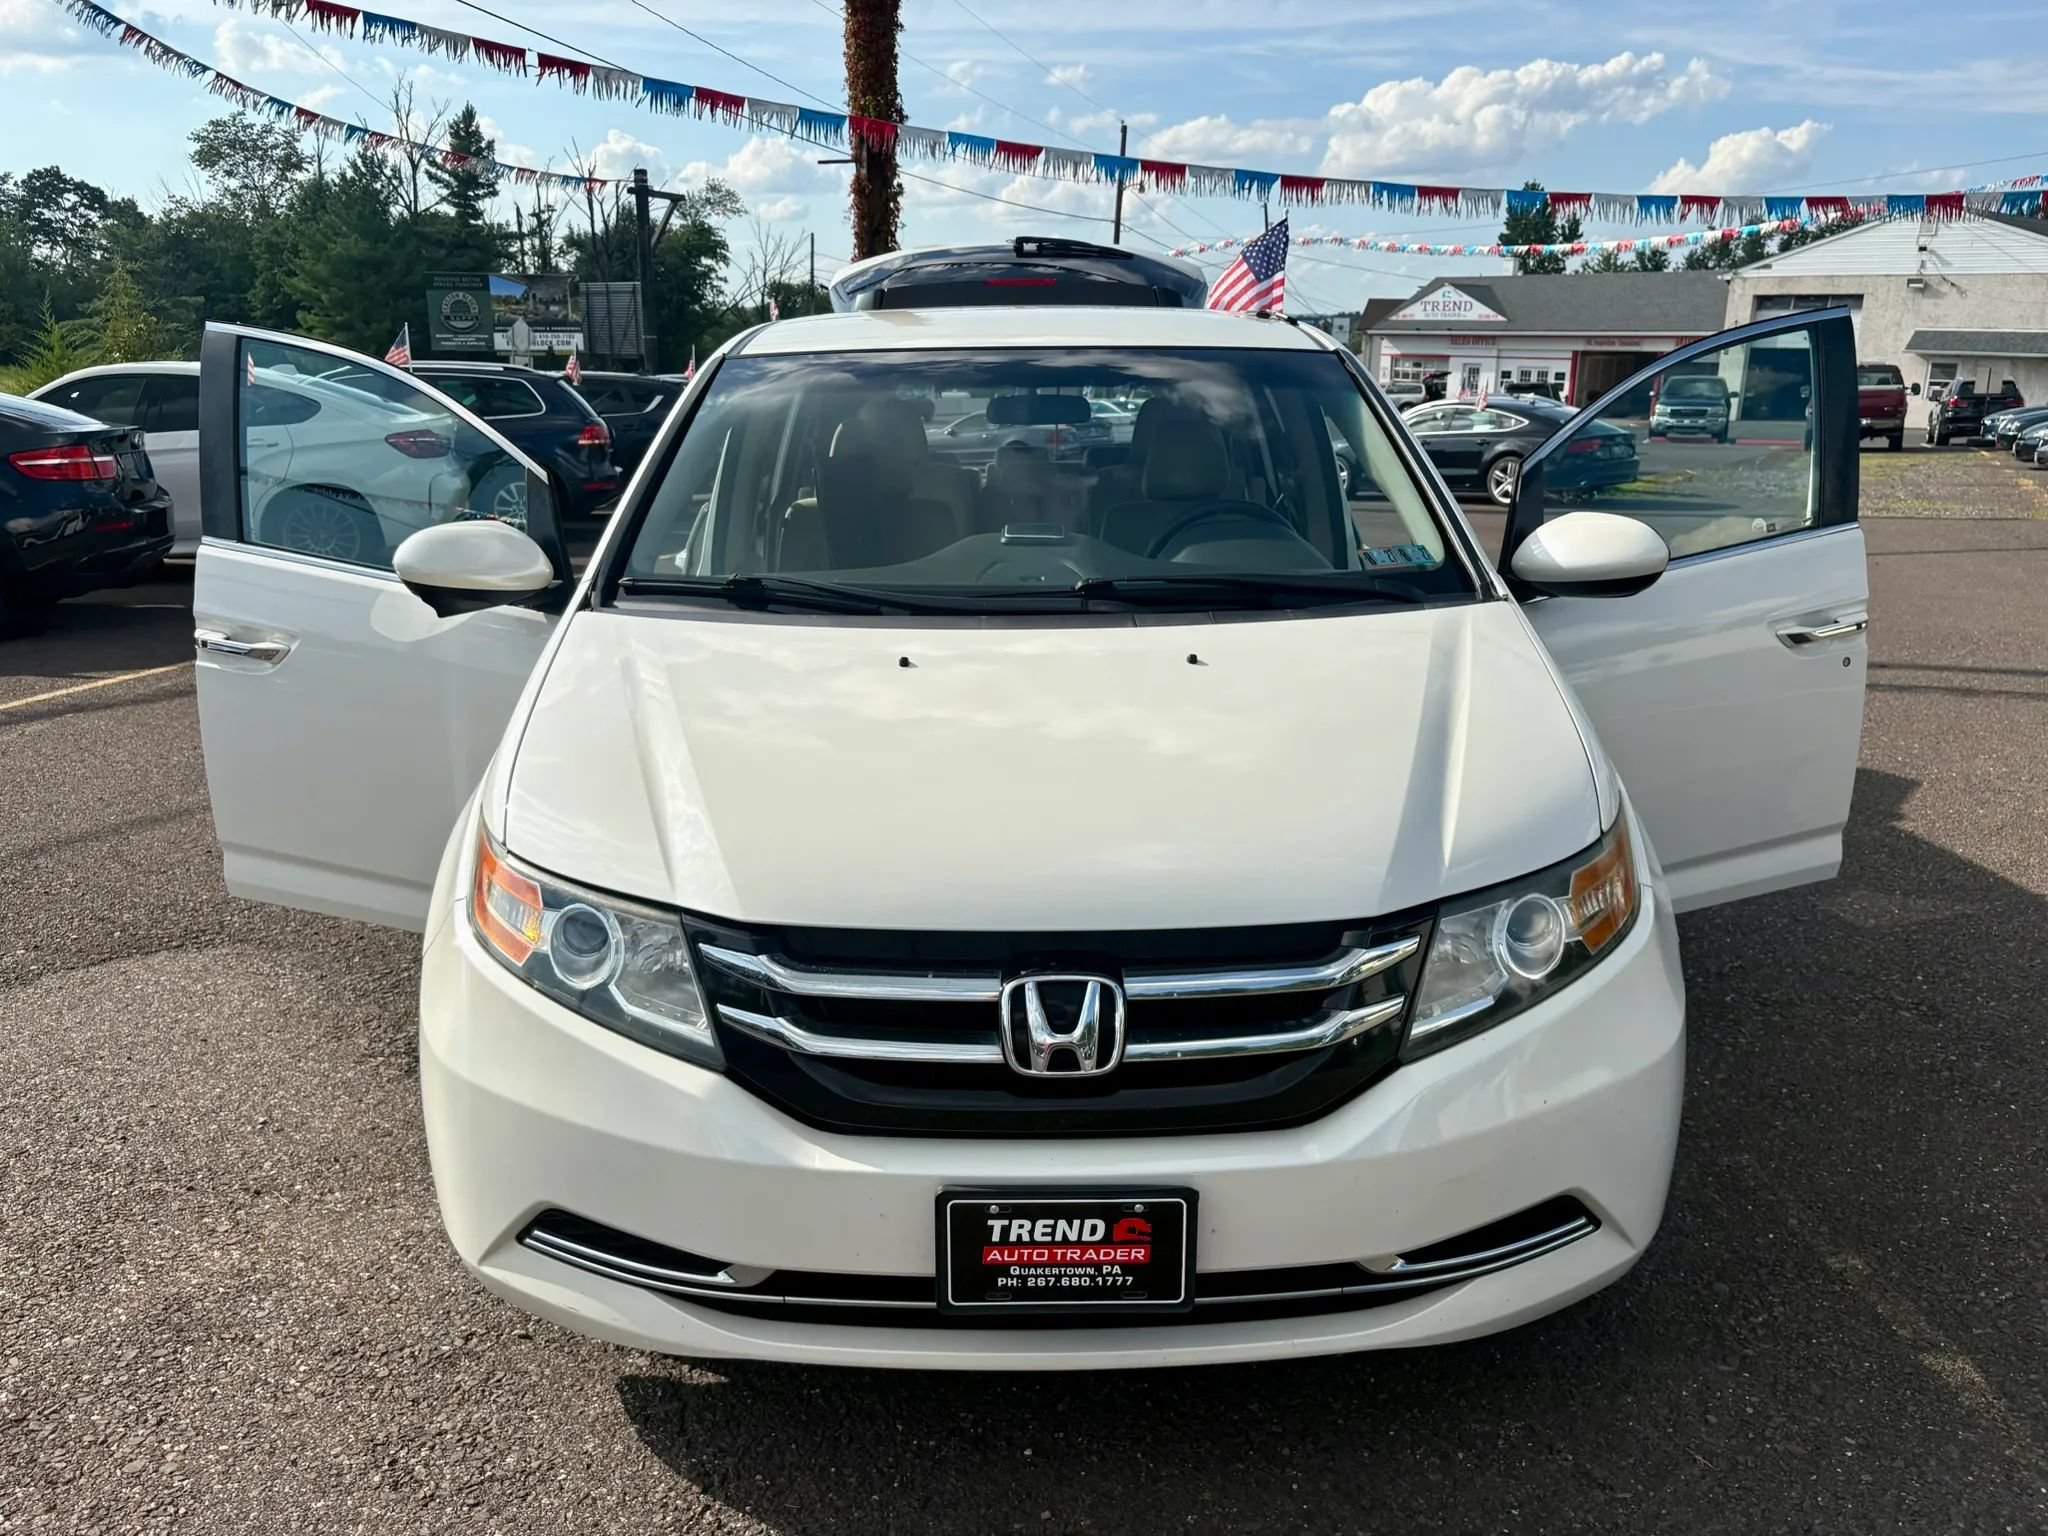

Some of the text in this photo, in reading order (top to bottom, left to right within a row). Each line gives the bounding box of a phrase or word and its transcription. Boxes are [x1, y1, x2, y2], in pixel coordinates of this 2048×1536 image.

[1420, 300, 1473, 313] TREND
[987, 1218, 1106, 1242] TREND
[986, 1248, 1146, 1262] AUTO TRADER
[1102, 1265, 1122, 1275] PA
[997, 1276, 1134, 1288] PH: 267.680.1777
